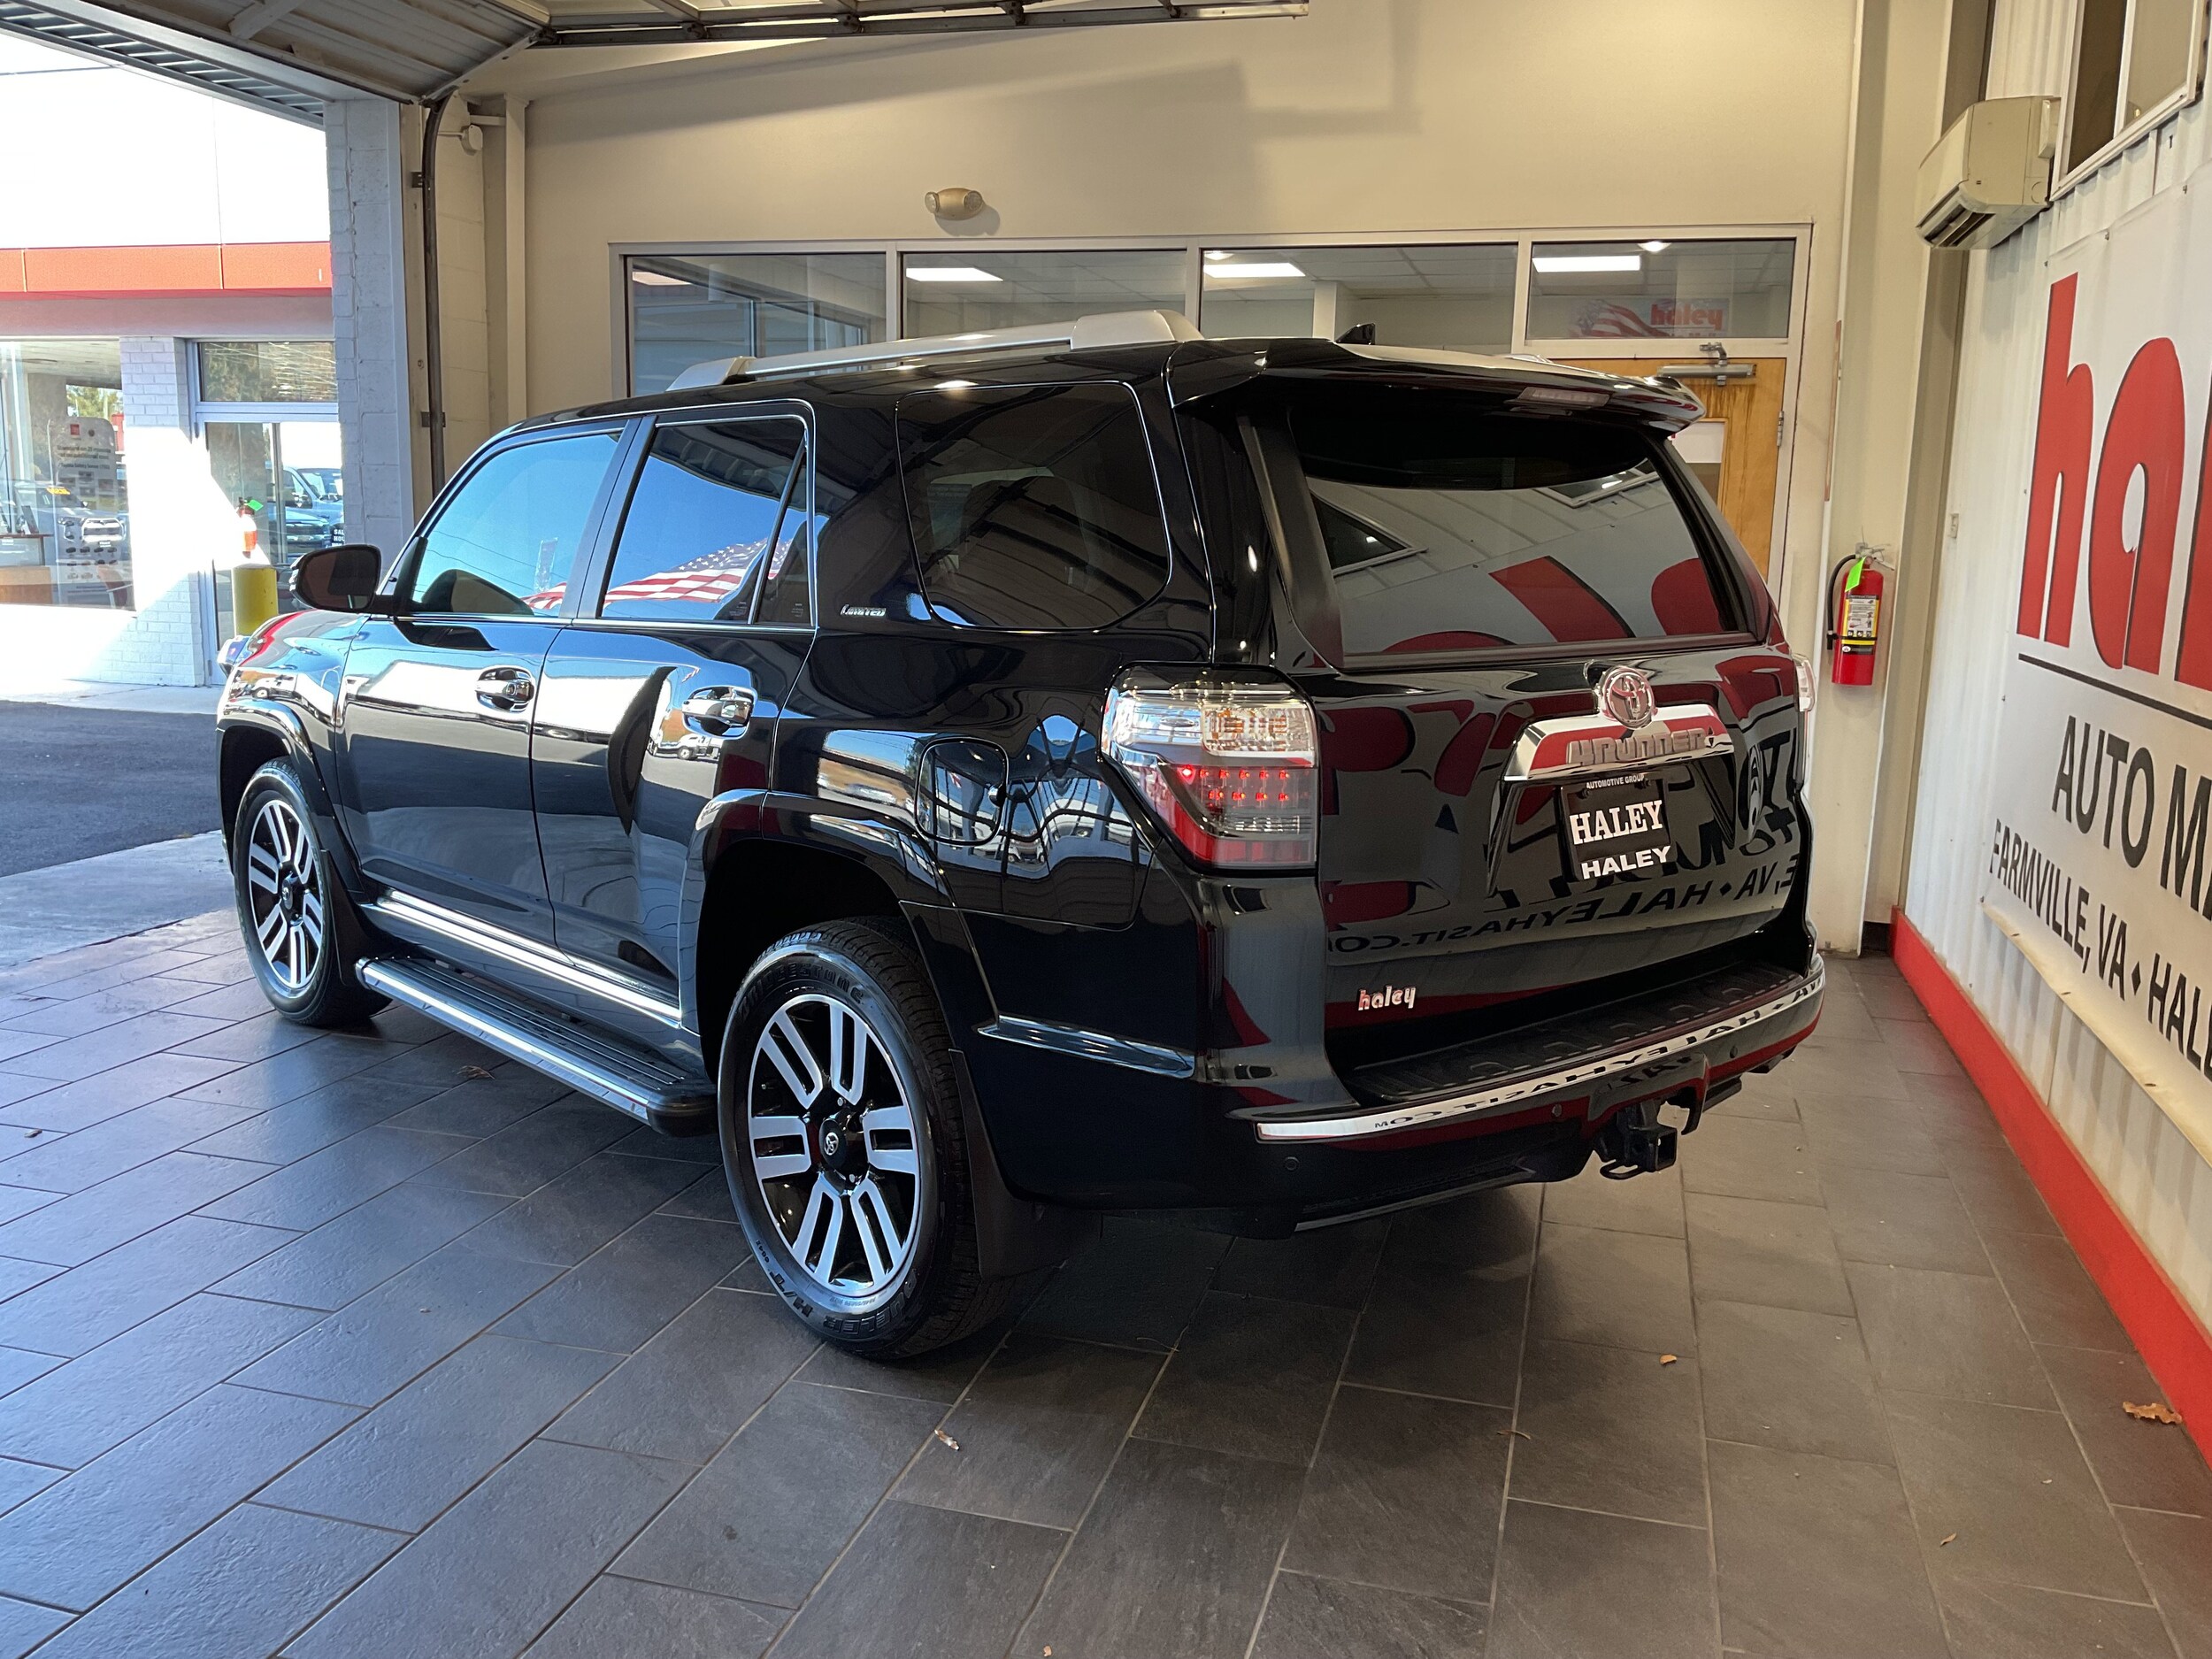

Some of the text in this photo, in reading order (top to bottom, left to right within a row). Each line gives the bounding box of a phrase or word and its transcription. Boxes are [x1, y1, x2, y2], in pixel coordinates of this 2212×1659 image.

[1650, 303, 1723, 331] haley
[1586, 773, 1645, 789] AUTOMOTIVE GROUP
[1569, 799, 1663, 845] HALEY
[2052, 715, 2212, 923] AUTO M
[1581, 845, 1671, 880] HALEY
[1989, 818, 2091, 974] FARMVILLE,
[2099, 902, 2129, 1002] VA
[1358, 985, 1416, 1011] haley
